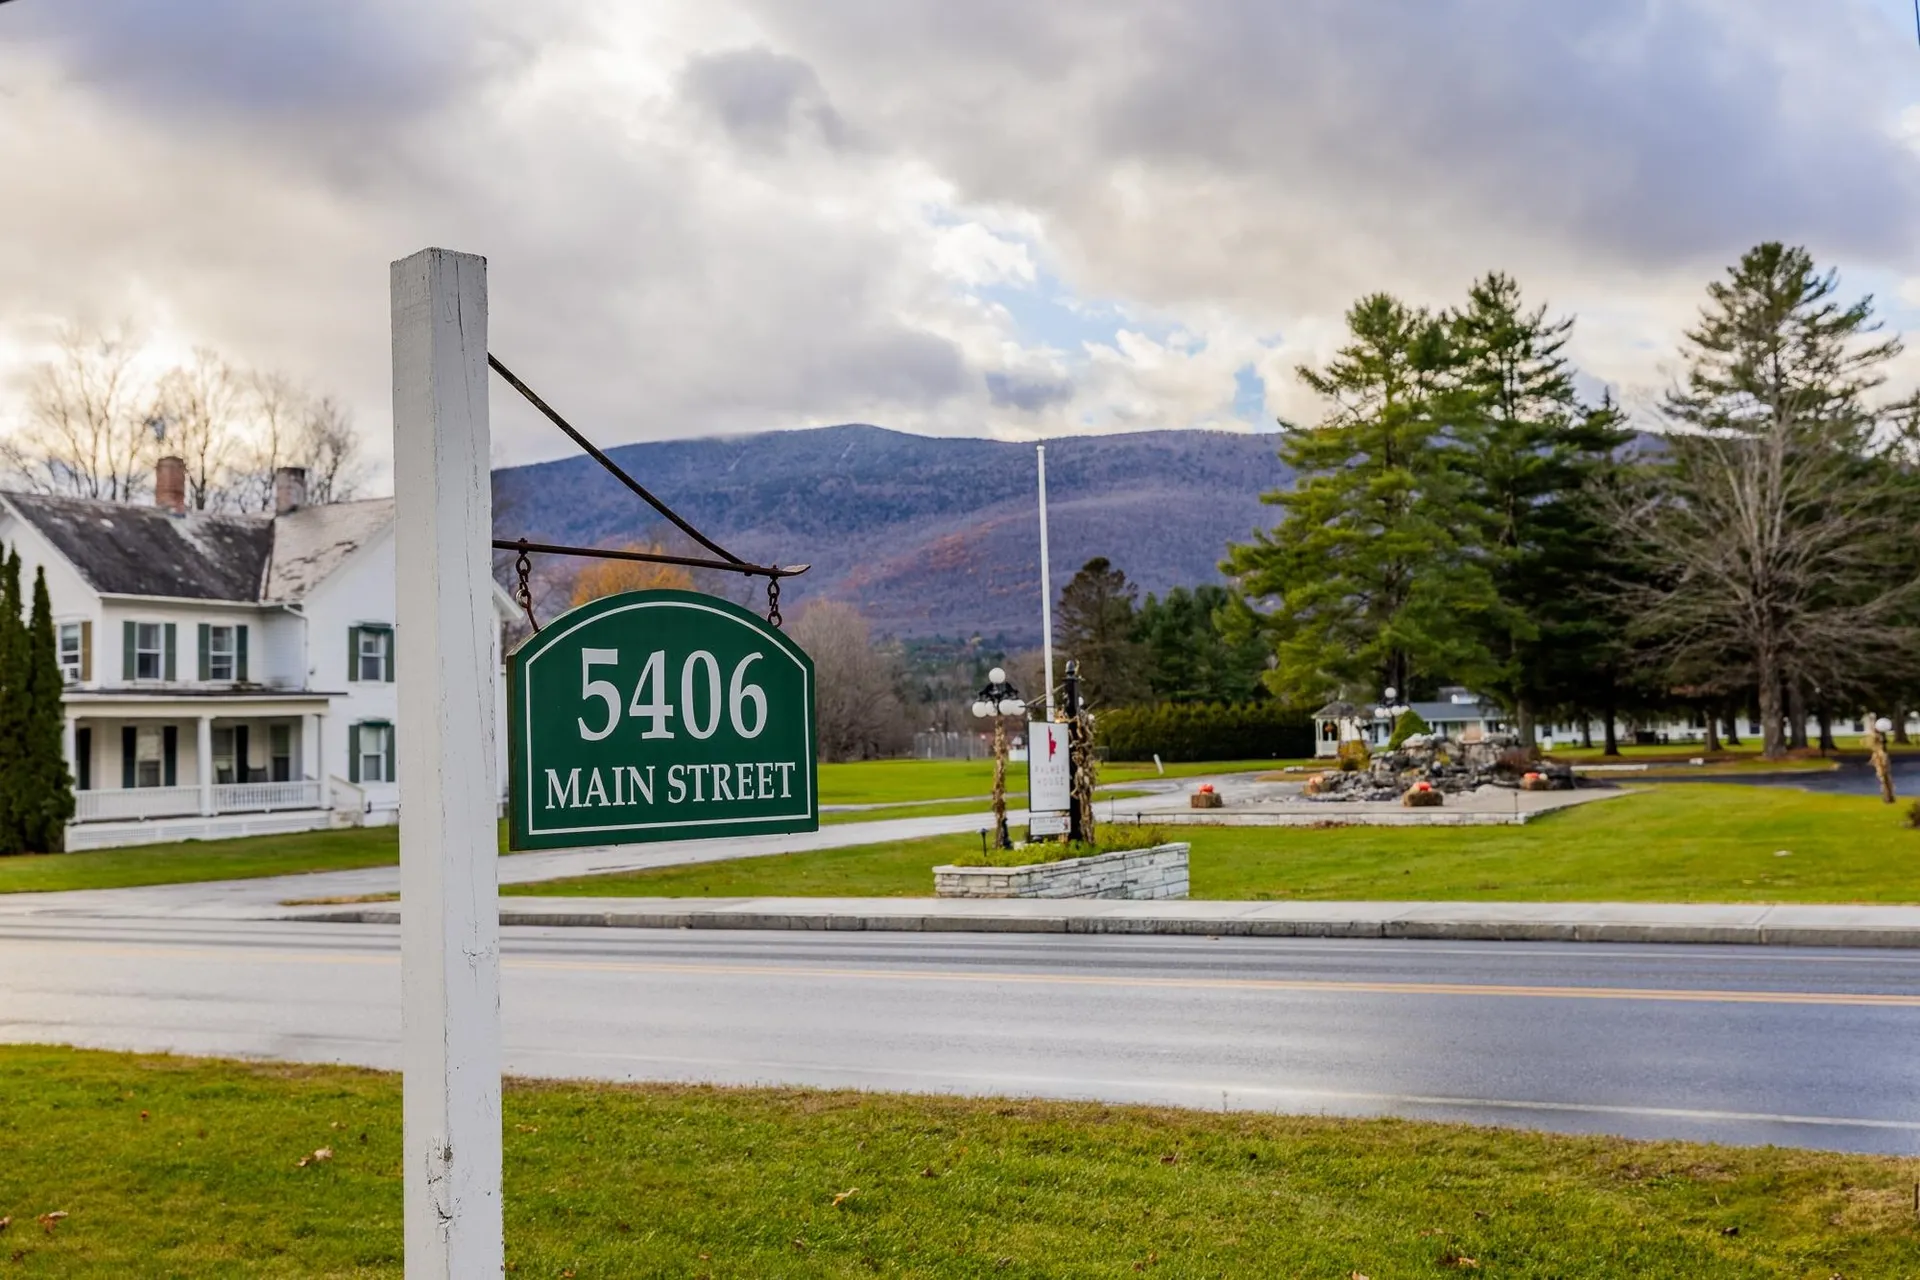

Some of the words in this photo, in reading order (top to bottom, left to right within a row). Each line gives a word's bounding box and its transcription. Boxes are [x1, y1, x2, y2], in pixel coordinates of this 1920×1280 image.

[577, 647, 768, 741] 5406
[545, 766, 656, 809] MAIN
[667, 762, 796, 804] STREET
